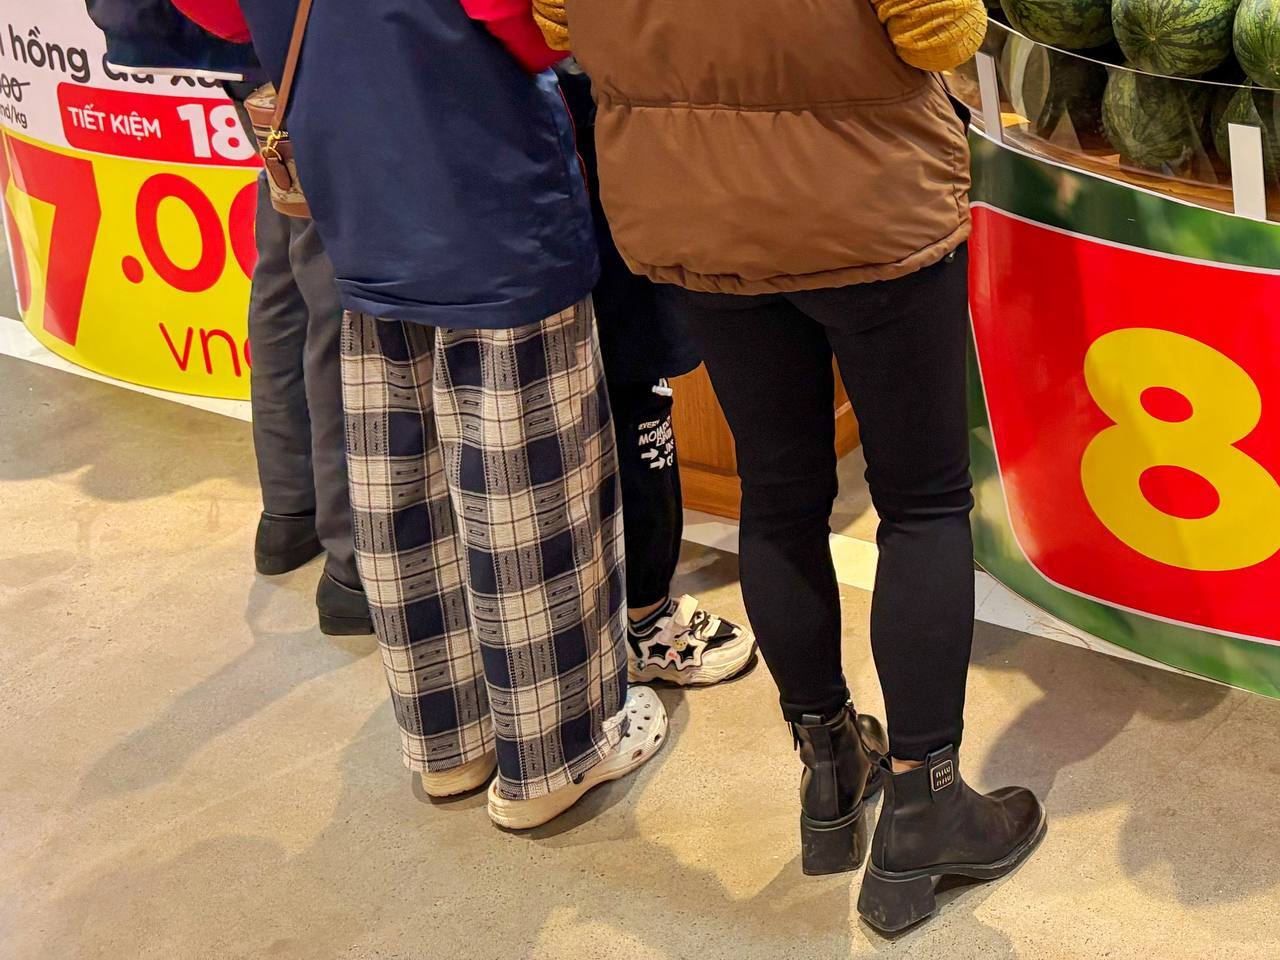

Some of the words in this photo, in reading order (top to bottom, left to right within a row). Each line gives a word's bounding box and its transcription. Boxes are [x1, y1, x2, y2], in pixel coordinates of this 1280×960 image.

[8, 23, 91, 83] hồng
[67, 103, 106, 131] TIẾT
[109, 111, 162, 141] KIỆM
[159, 323, 252, 377] vn
